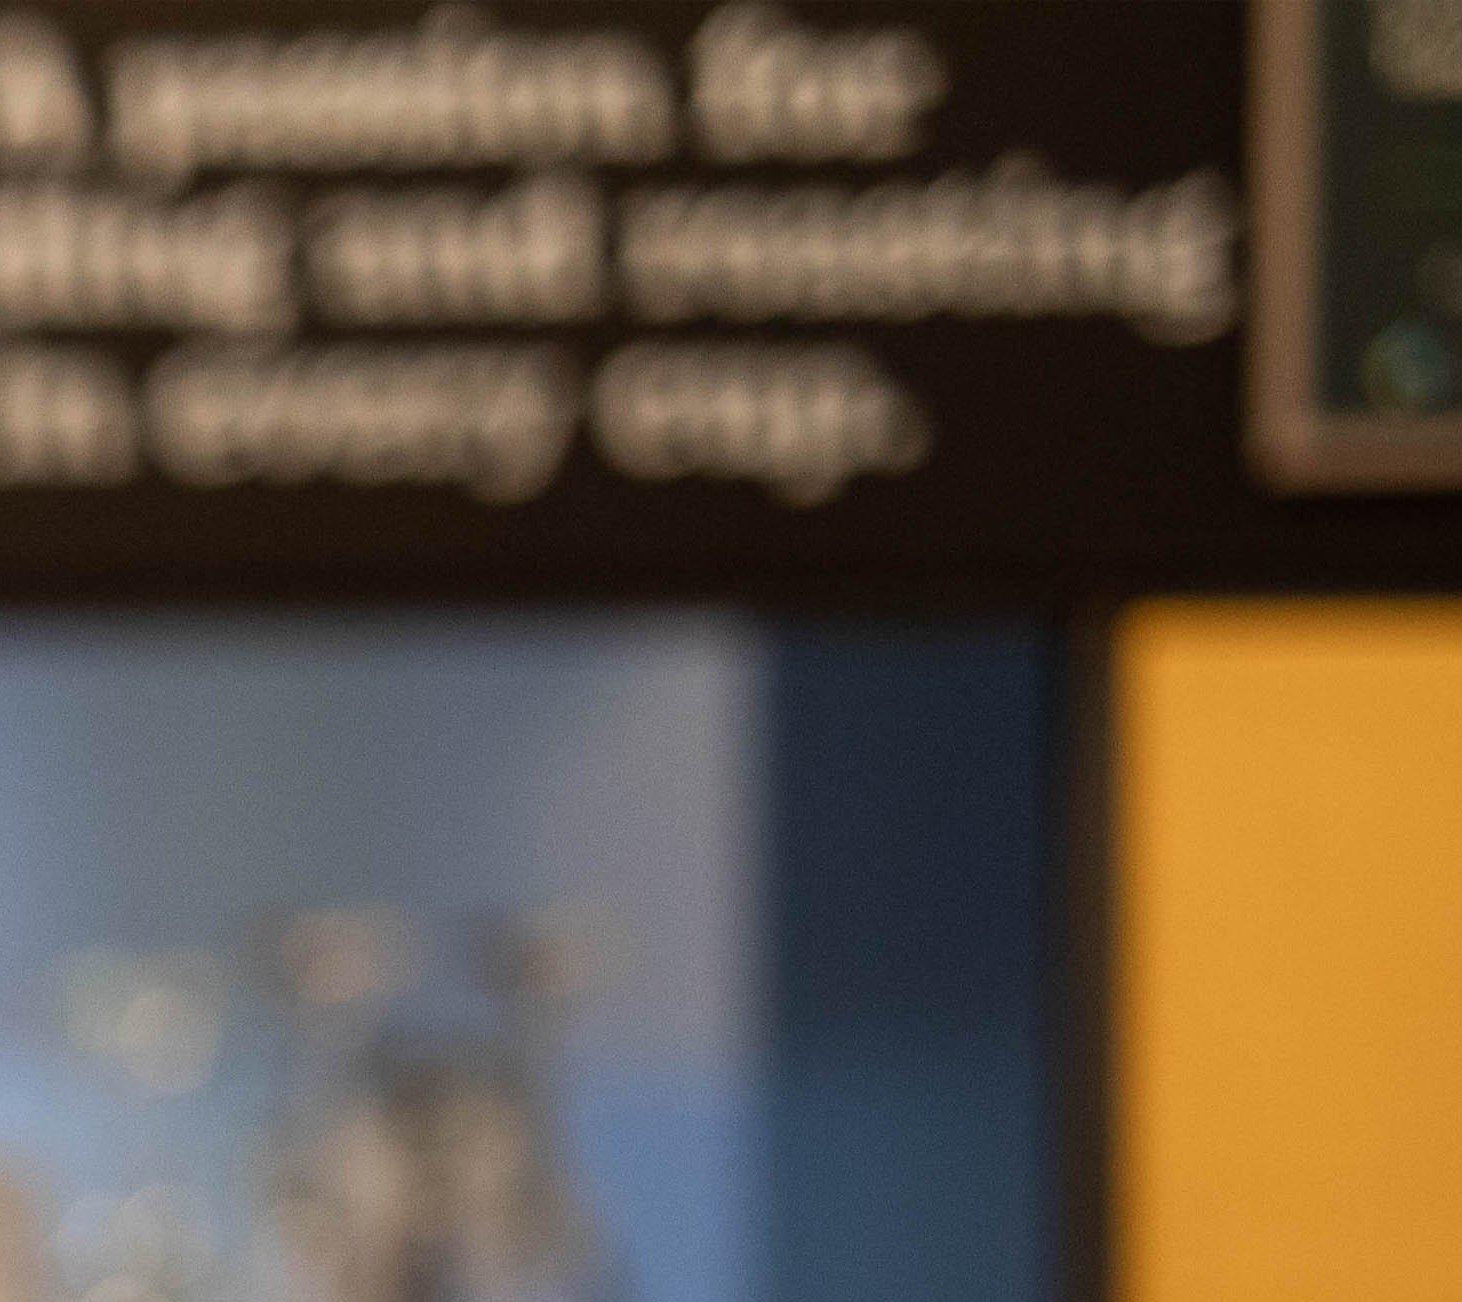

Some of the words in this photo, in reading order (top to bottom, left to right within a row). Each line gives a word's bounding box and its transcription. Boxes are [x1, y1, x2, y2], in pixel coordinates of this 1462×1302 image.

[108, 12, 678, 190] passion
[688, 6, 941, 162] for
[303, 180, 601, 325] and
[618, 160, 1235, 342] roasting
[143, 345, 573, 497] every
